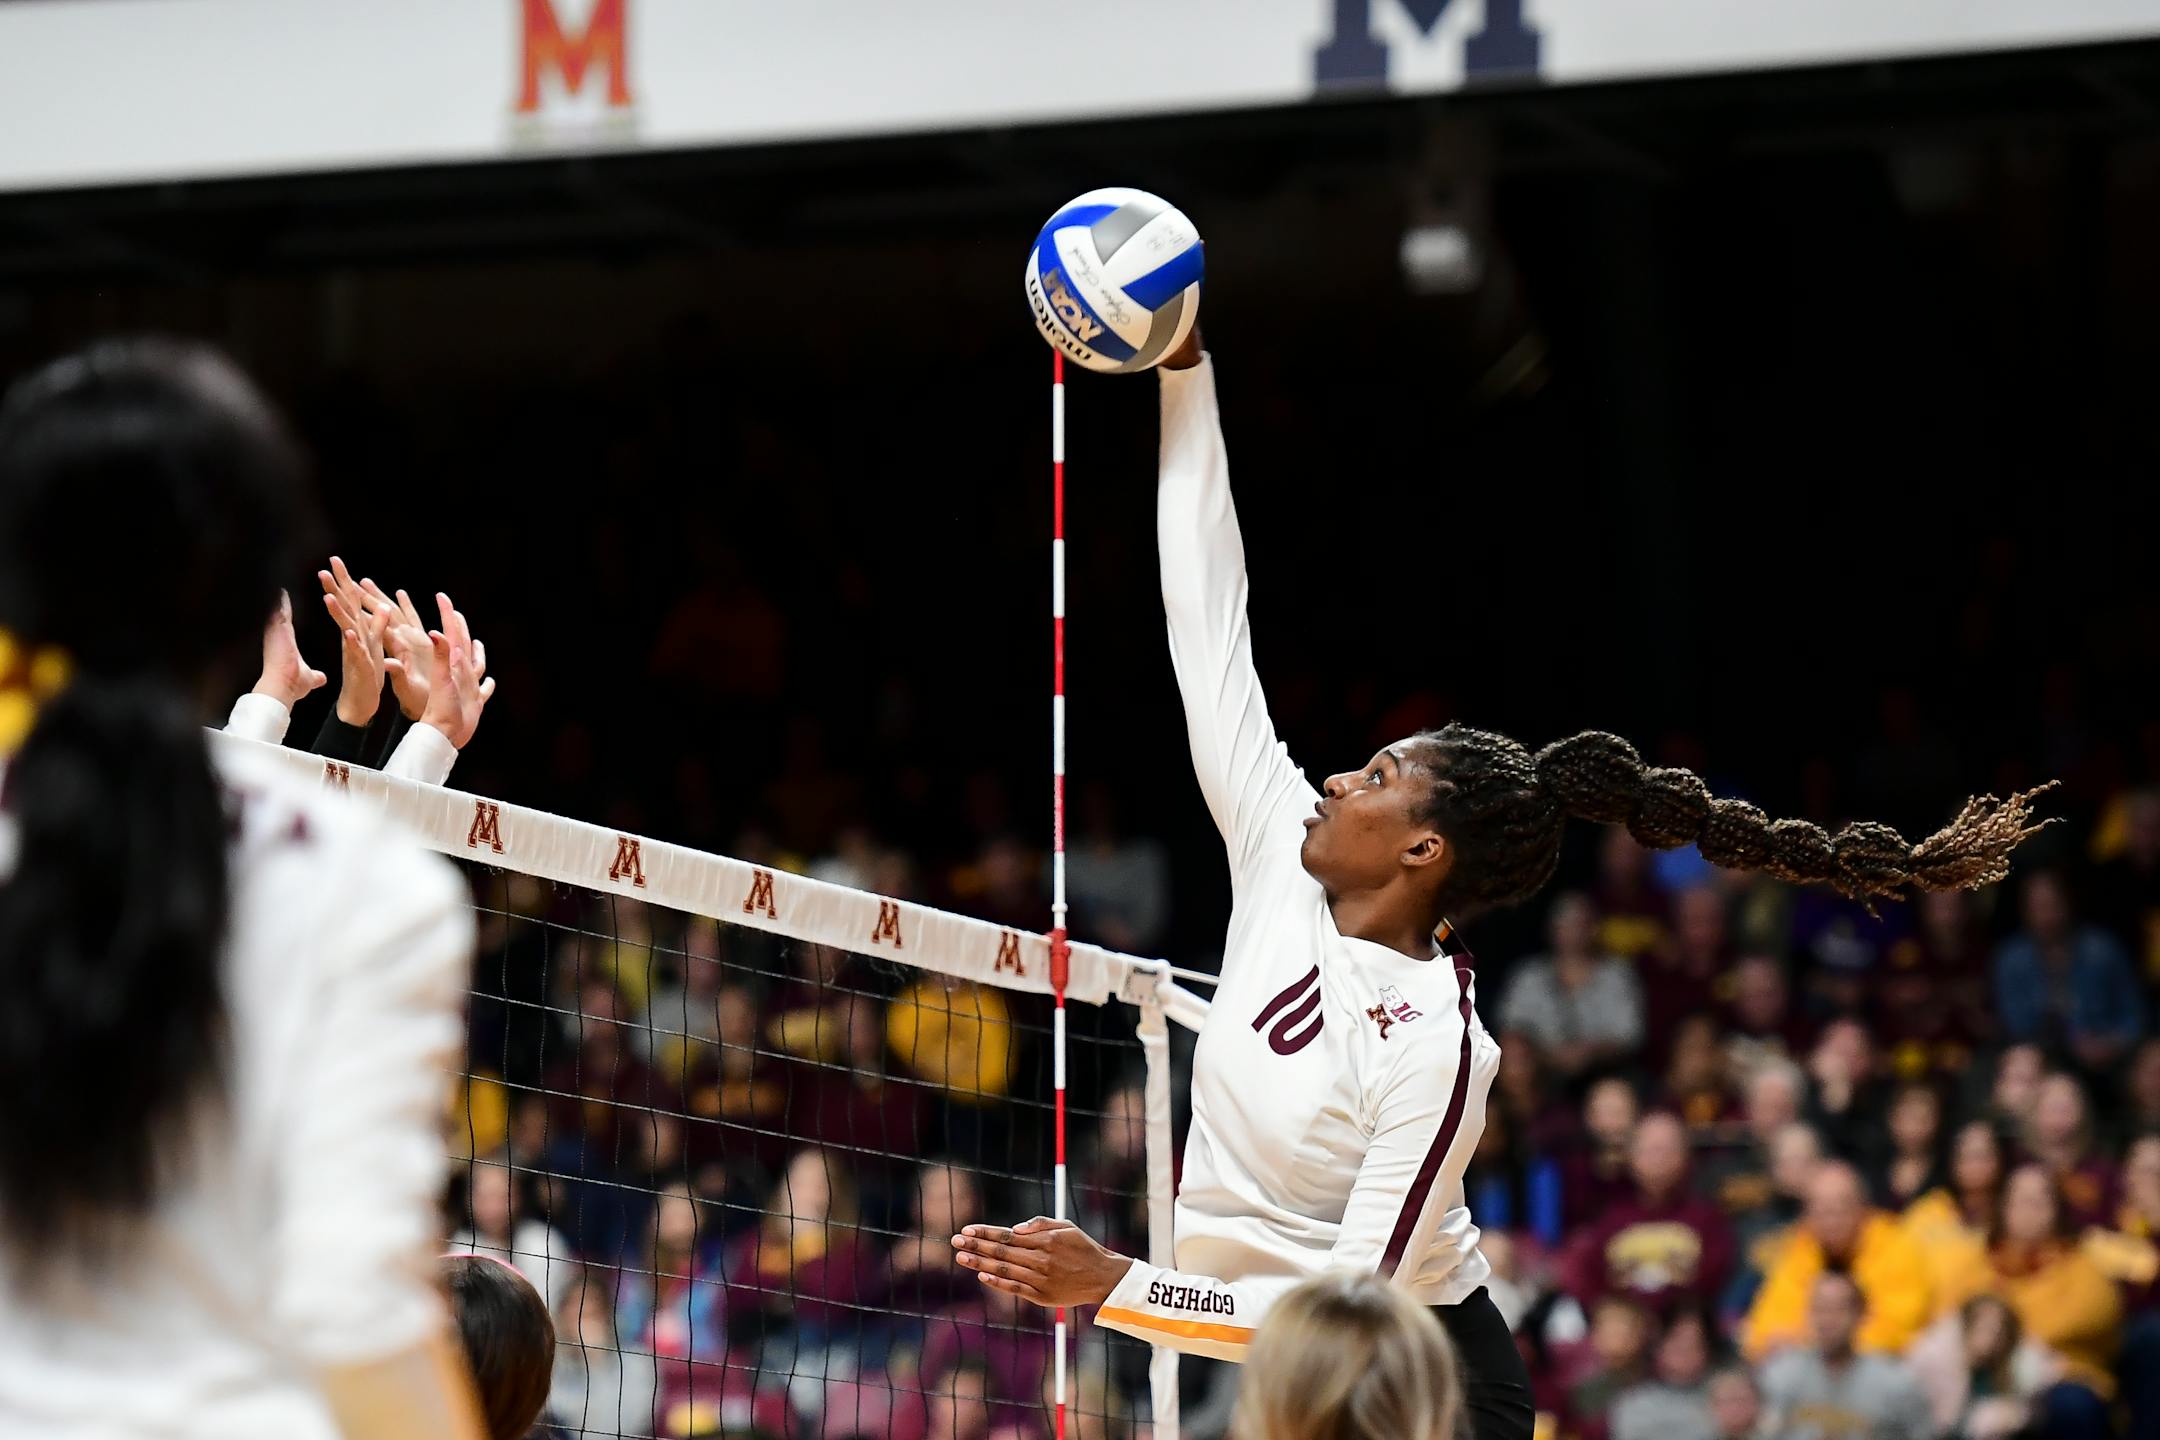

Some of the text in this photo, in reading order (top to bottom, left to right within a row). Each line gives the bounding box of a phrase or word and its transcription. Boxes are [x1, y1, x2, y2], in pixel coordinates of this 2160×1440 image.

[1029, 278, 1092, 360] molten
[1041, 267, 1104, 343] NCAA
[467, 800, 504, 854] M
[608, 834, 646, 888] M
[742, 867, 778, 920] M
[872, 900, 904, 949] M
[994, 931, 1026, 976] M
[1251, 964, 1324, 1055] 10
[1147, 1281, 1235, 1316] GOPHERS
